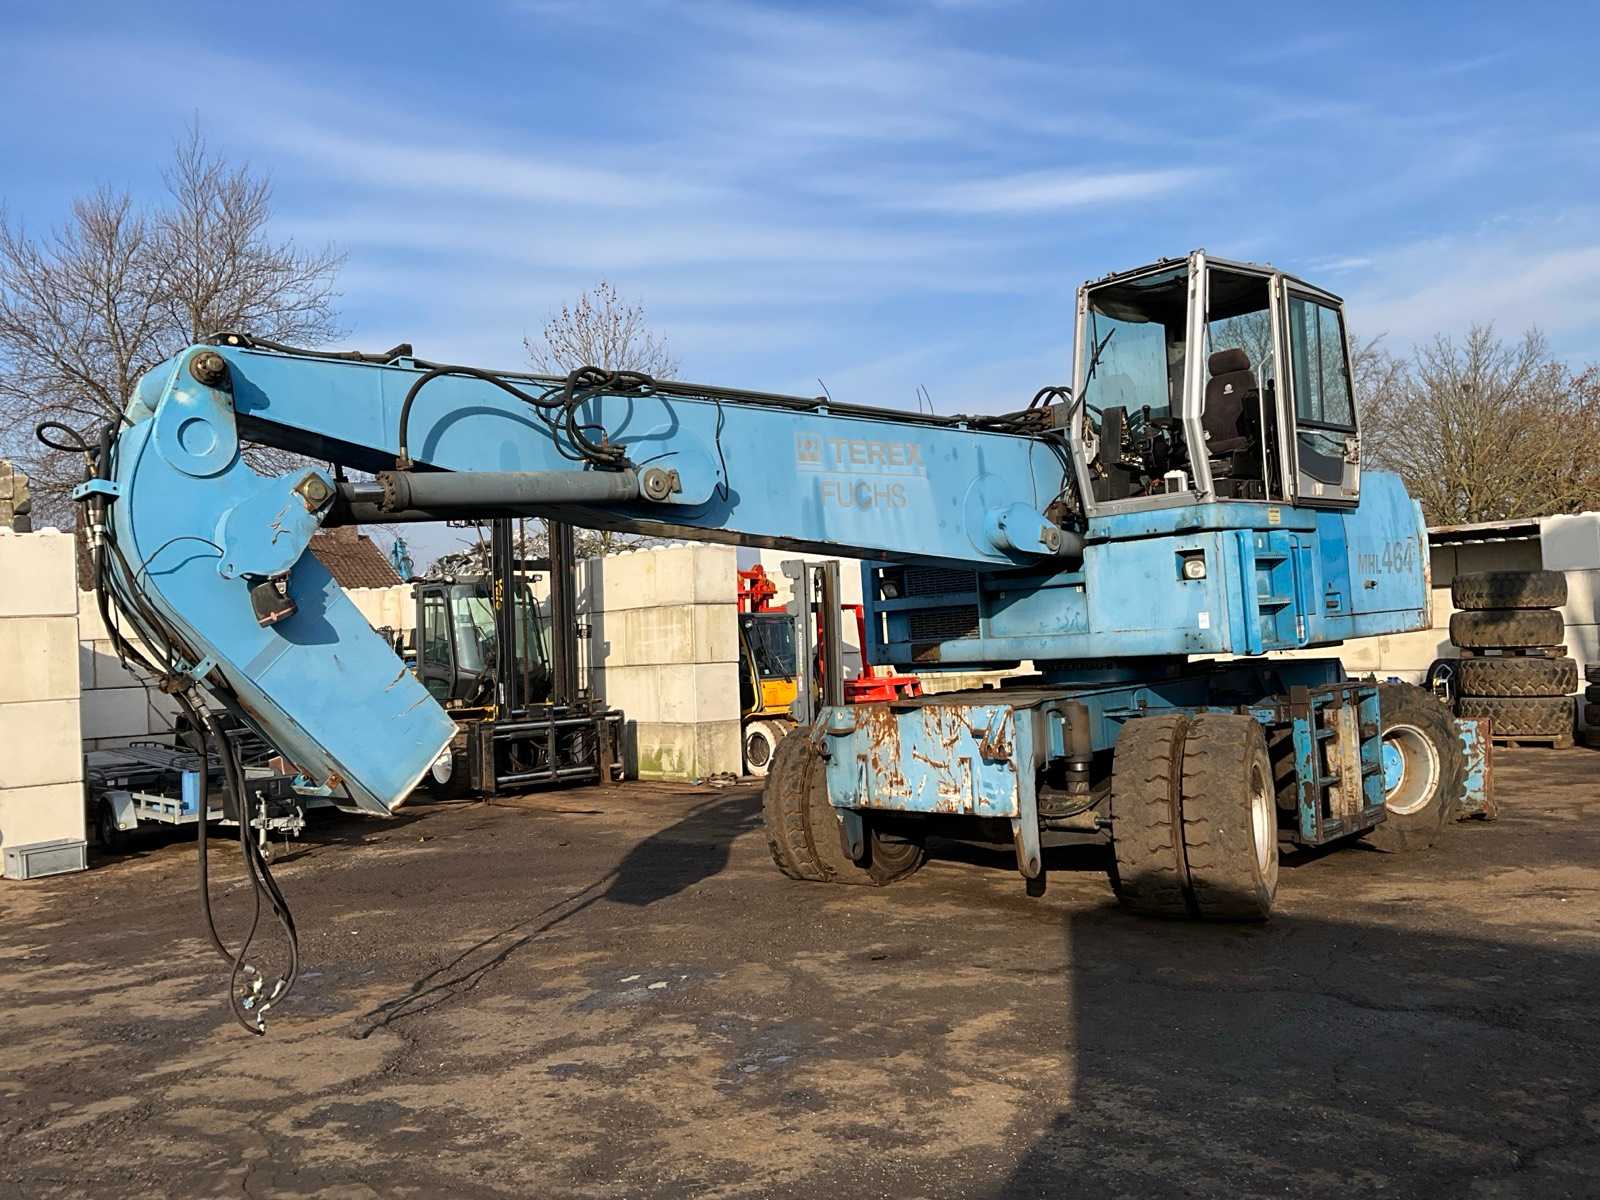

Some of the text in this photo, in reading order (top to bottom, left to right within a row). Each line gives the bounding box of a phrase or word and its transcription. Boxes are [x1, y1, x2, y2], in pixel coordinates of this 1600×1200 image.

[827, 437, 925, 466] TEREX
[821, 479, 908, 511] FUCHS
[1382, 541, 1413, 575] 464
